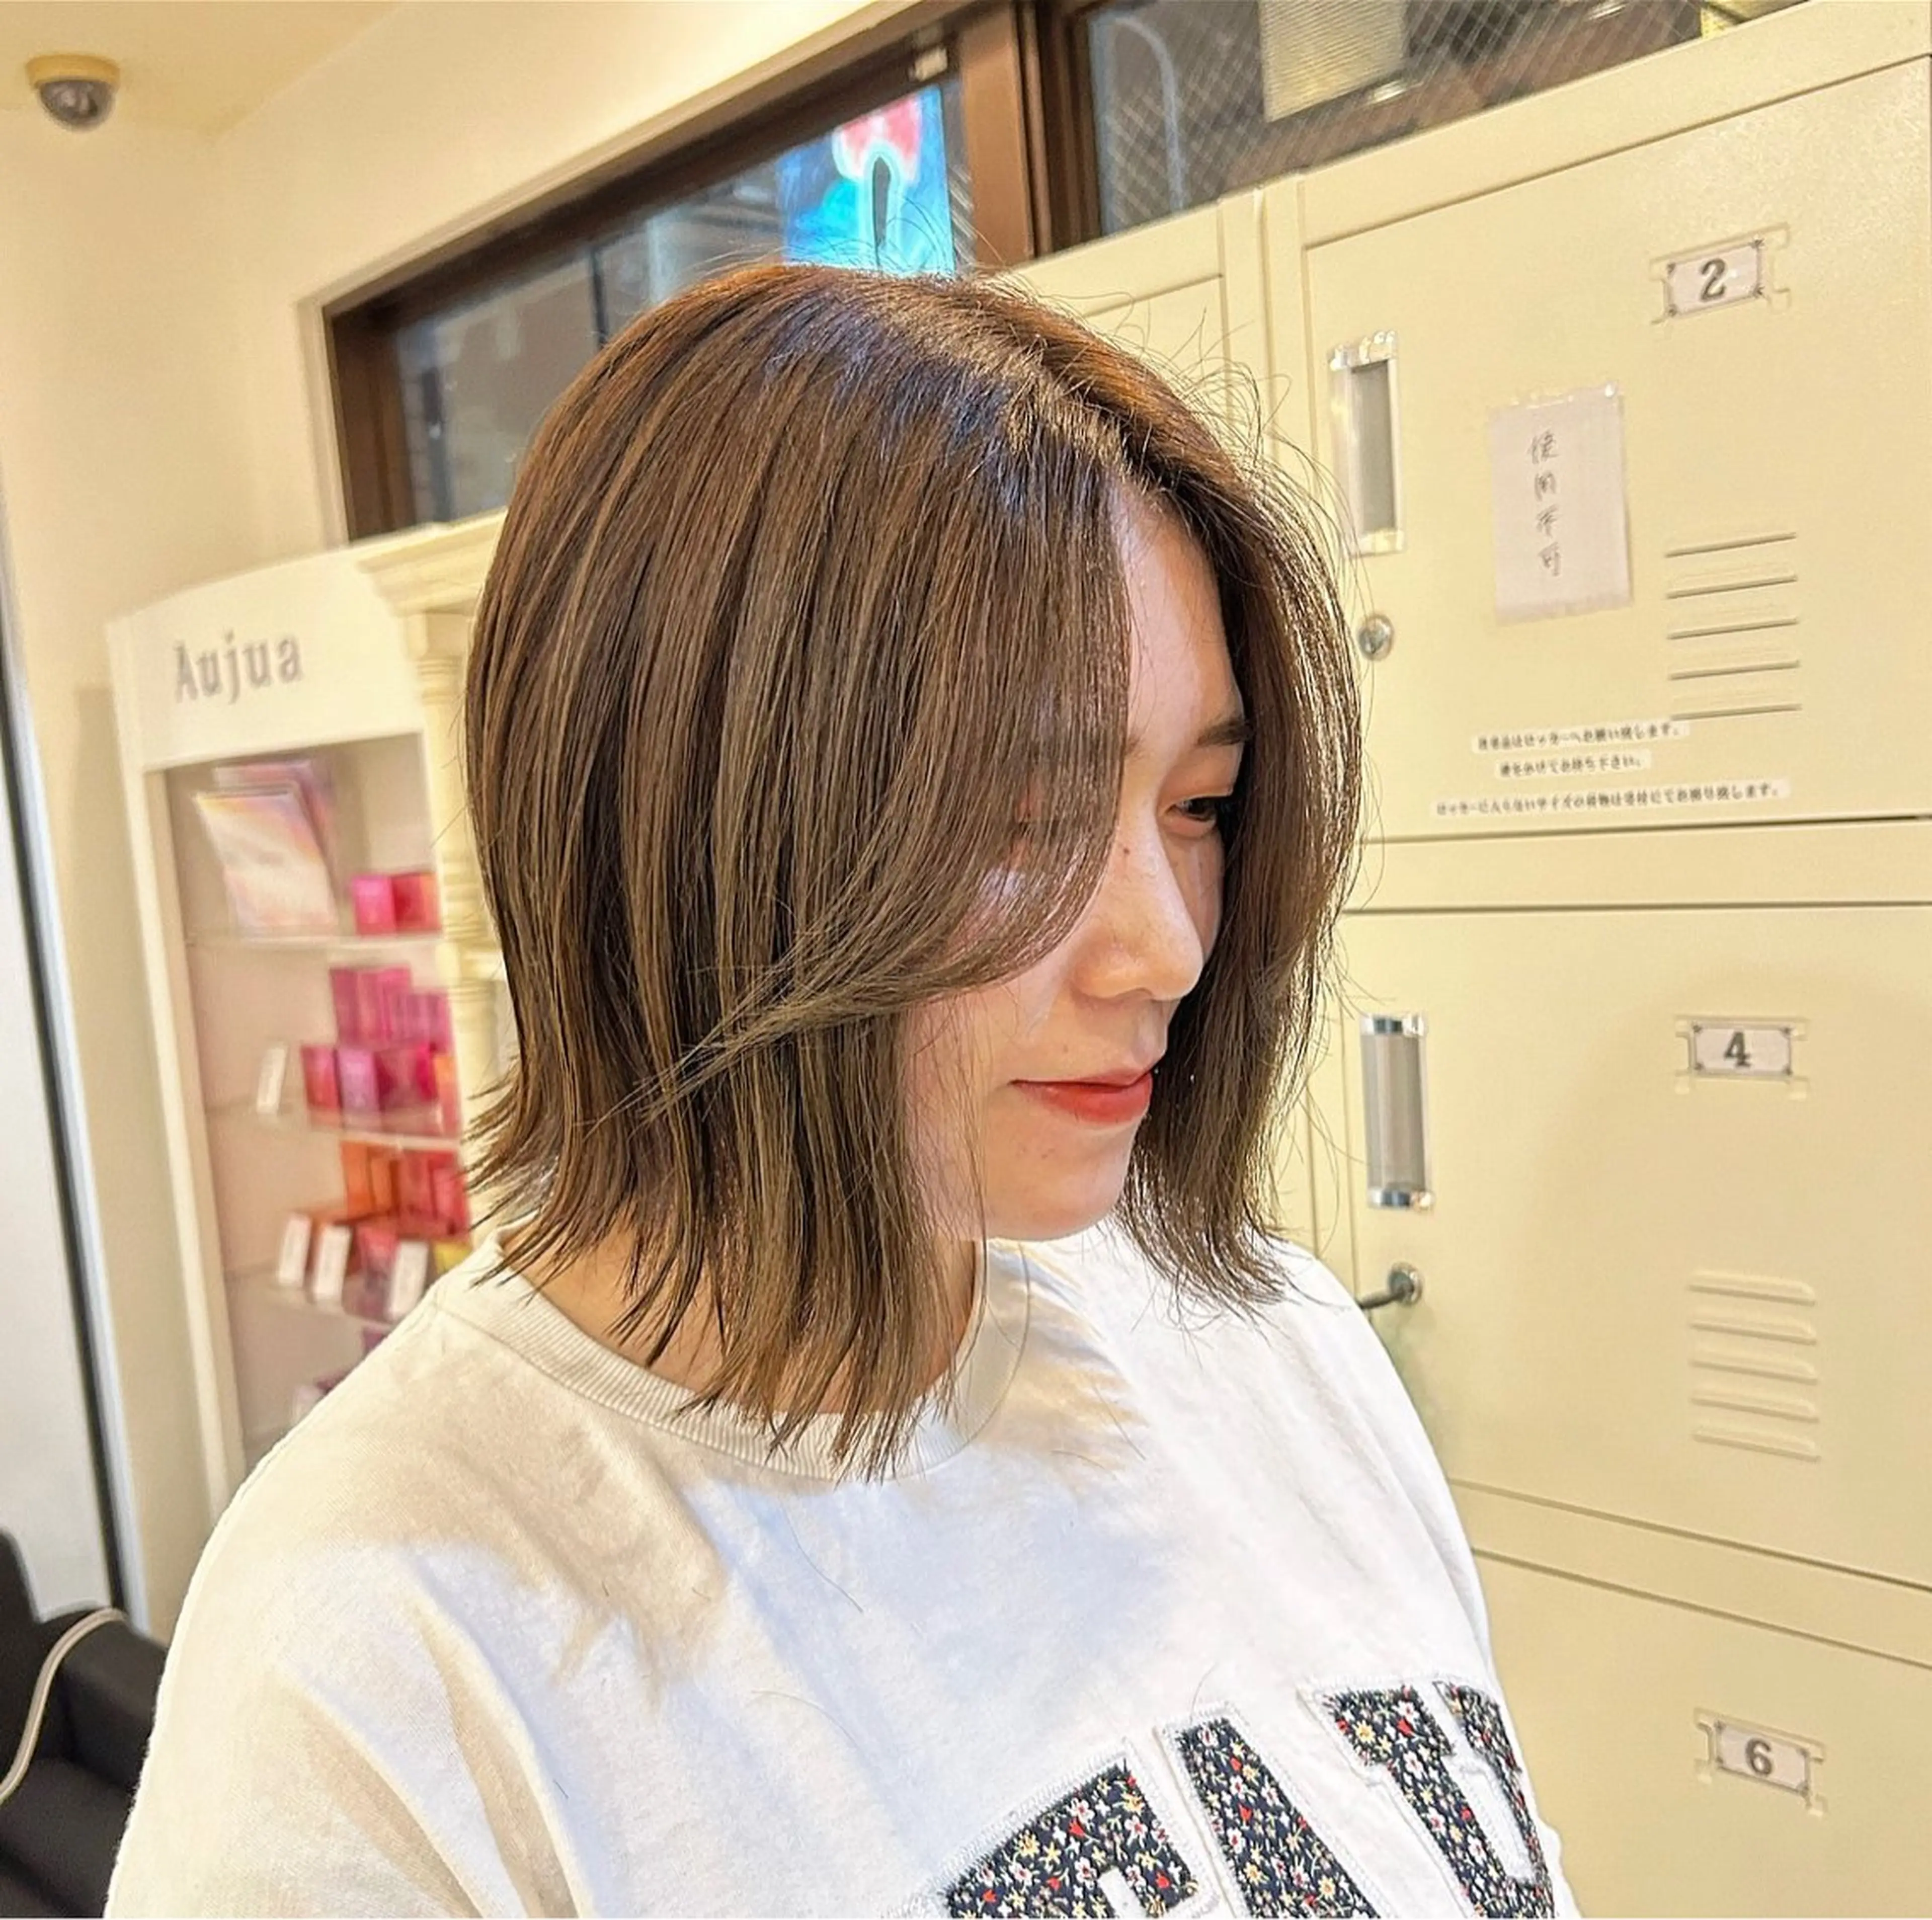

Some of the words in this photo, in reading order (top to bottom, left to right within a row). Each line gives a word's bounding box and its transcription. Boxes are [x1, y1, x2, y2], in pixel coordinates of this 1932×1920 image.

[1700, 258, 1726, 301] 2
[1528, 429, 1561, 577] 使用不可
[173, 629, 304, 704] Aujua
[1724, 1031, 1751, 1067] 4
[1746, 1738, 1773, 1776] 6
